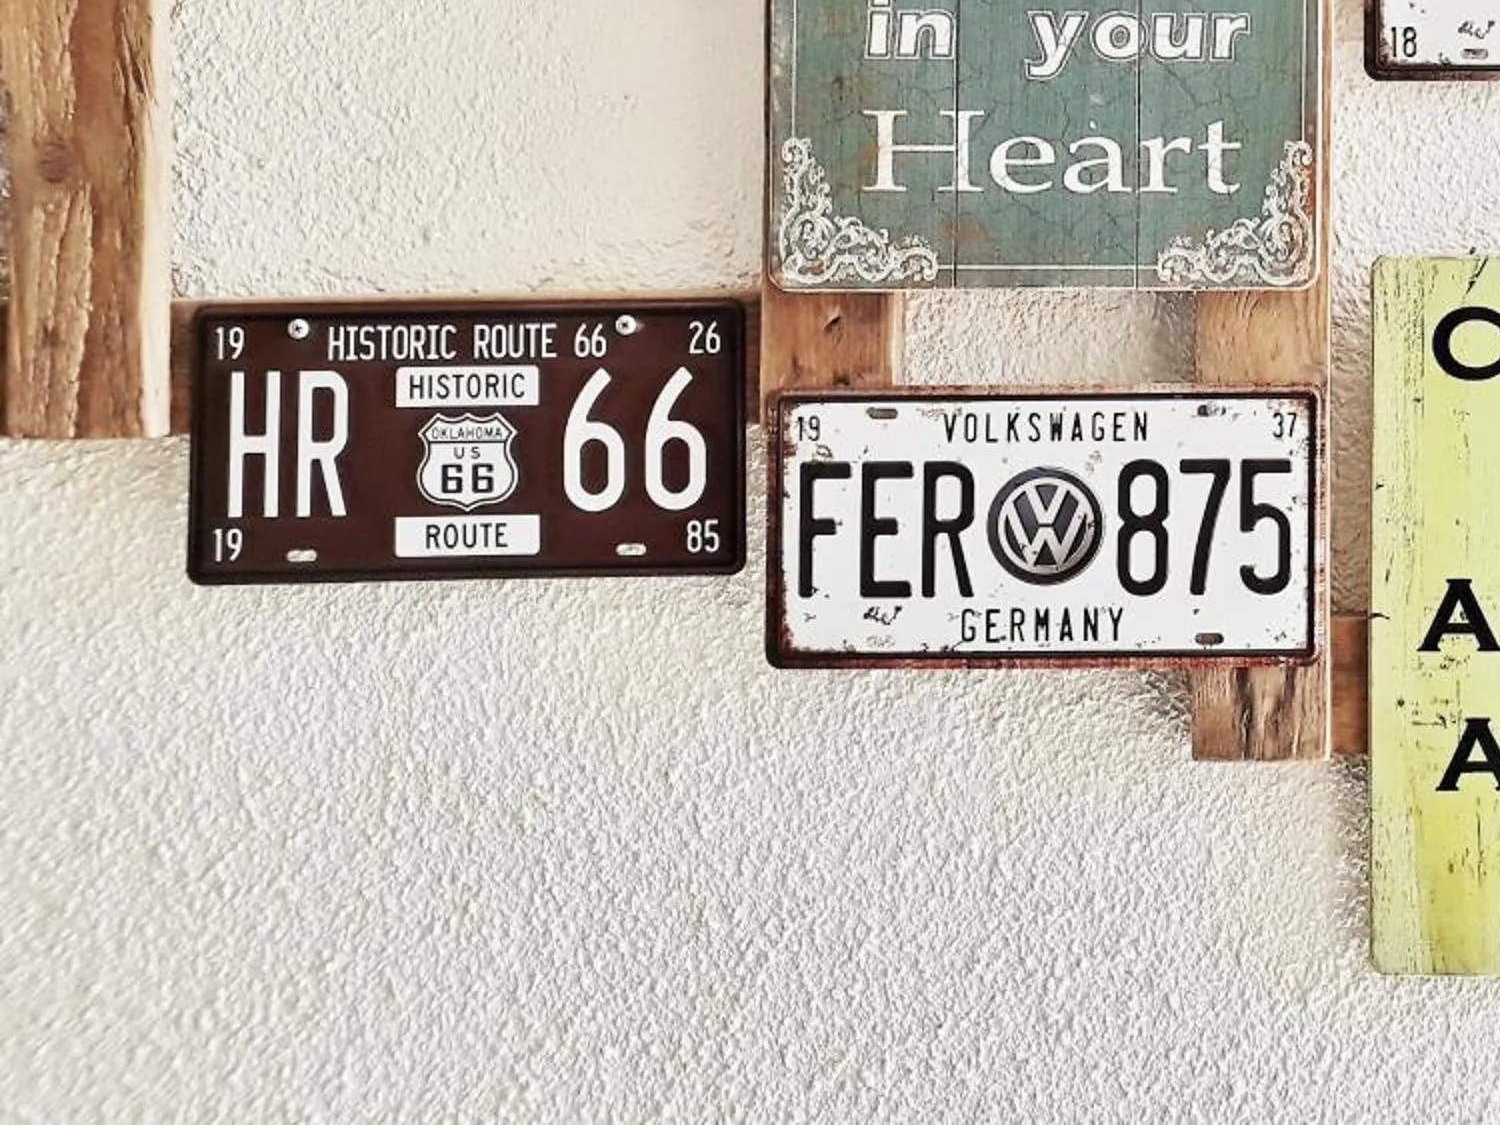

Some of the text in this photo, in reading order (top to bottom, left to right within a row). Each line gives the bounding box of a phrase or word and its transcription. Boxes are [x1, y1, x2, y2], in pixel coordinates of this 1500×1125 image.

[1024, 10, 1251, 81] your
[1389, 27, 1418, 59] 18
[862, 109, 1243, 195] Heart
[214, 320, 722, 362] 19 HISTORIC ROUTE 66 26
[408, 373, 527, 401] HISTORIC
[227, 365, 708, 519] HR 66
[431, 426, 503, 441] OKLAHOMA
[797, 411, 1298, 444] 19 VOLKSWAGEN 37
[441, 463, 495, 494] 66
[212, 518, 721, 563] 19 85
[424, 522, 509, 549] ROUTE
[799, 460, 976, 598] FER
[1117, 458, 1293, 596] 875
[959, 607, 1126, 644] GERMANY
